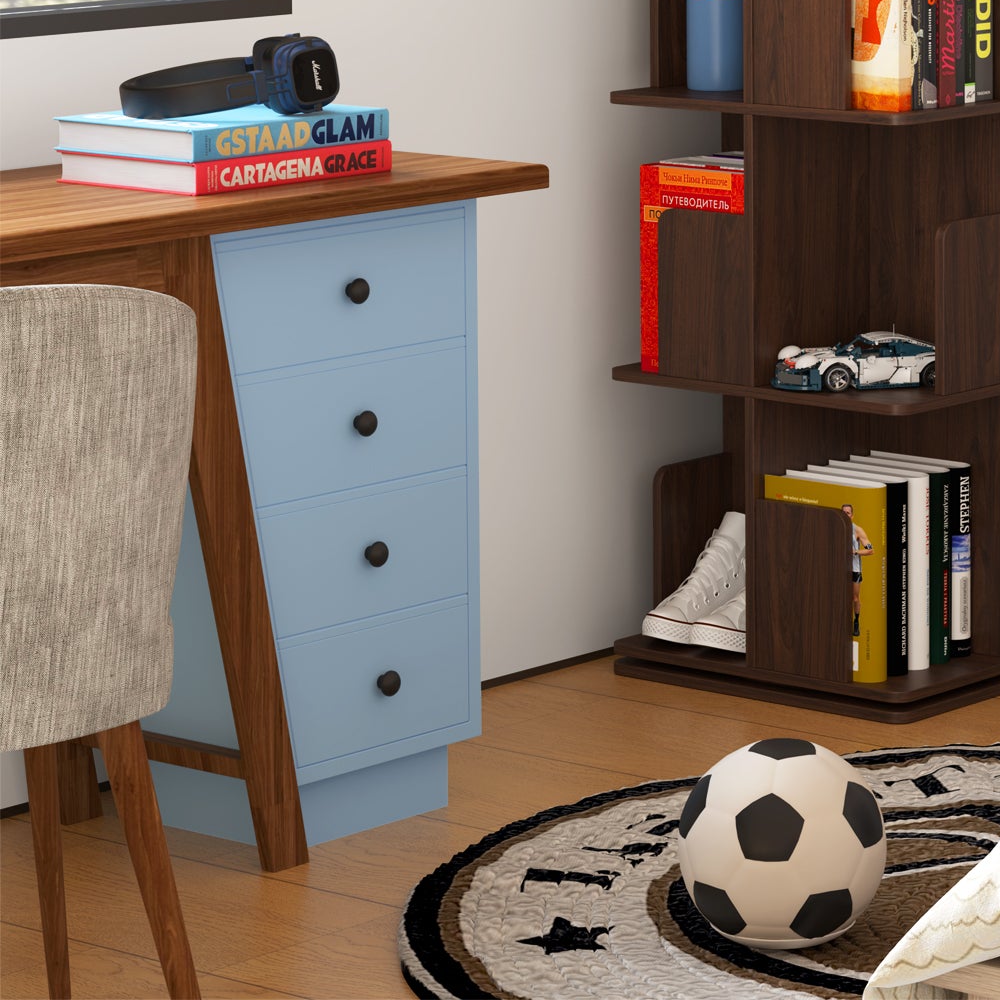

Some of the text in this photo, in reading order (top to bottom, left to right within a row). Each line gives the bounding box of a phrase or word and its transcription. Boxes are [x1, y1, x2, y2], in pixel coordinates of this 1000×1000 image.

[311, 60, 323, 91] Marshall
[661, 194, 730, 211] ПУТЕВОДИТЕЛЬ
[959, 475, 970, 533] STEPHEN
